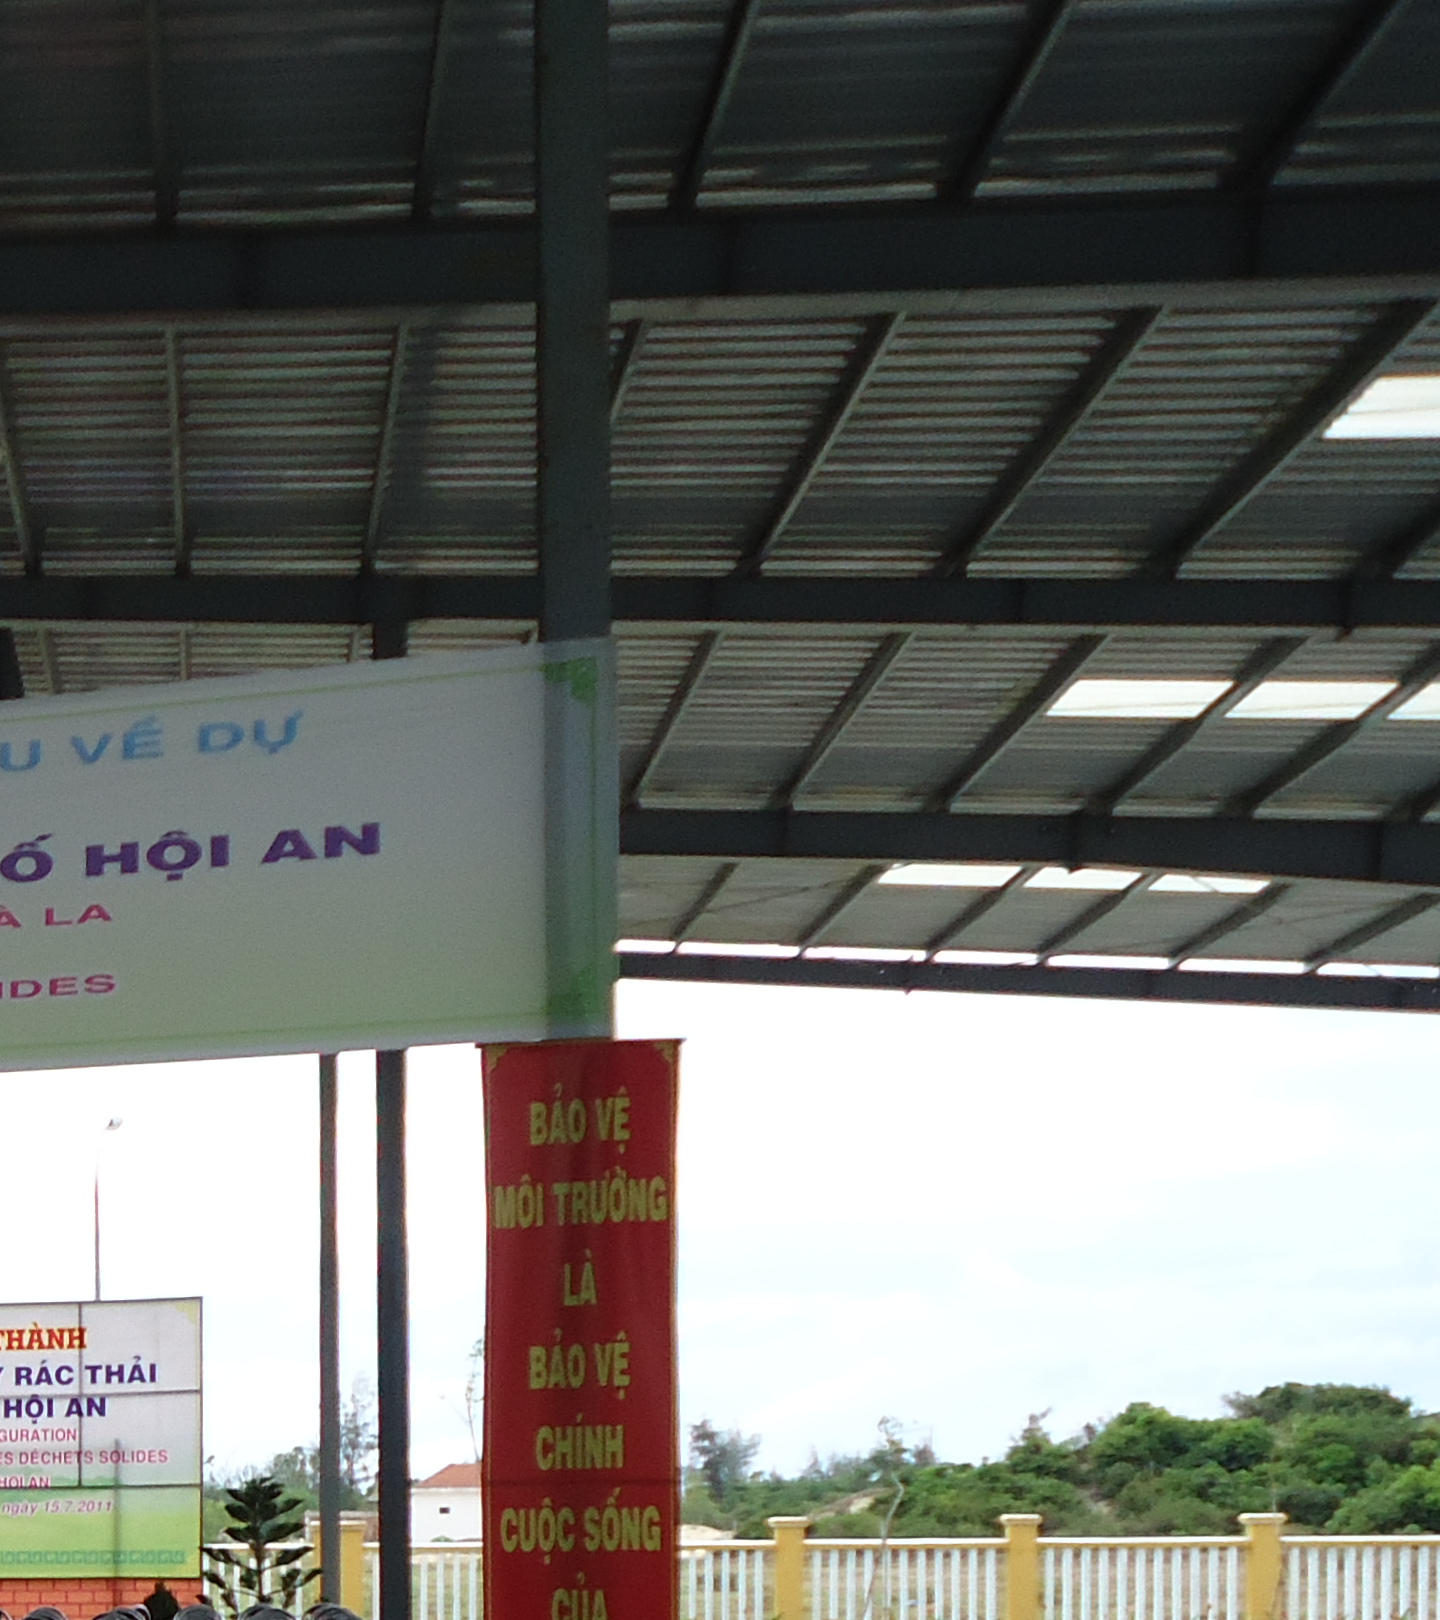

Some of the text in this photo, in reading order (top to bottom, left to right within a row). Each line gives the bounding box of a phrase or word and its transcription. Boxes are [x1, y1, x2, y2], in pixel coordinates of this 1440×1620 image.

[197, 710, 304, 756] DỰ
[84, 830, 231, 881] HỘI
[260, 822, 382, 865] AN
[44, 904, 113, 927] LA
[530, 1082, 631, 1154] BẢO VỆ
[493, 1165, 668, 1229] MÔI TRƯỜNG
[564, 1248, 597, 1307] LÀ
[15, 1359, 74, 1386] RÁC
[85, 1355, 157, 1384] THẢI
[529, 1327, 631, 1400] BẢO VỆ
[3, 1394, 54, 1424] HỘI
[65, 1396, 107, 1418] AN
[19, 1448, 94, 1465] DÉCHETS
[99, 1449, 168, 1464] SOLIDES
[535, 1412, 624, 1471] CHÍNH
[28, 1476, 50, 1488] AN
[1, 1502, 37, 1516] ngày
[500, 1487, 661, 1565] CUỘC SỐNG
